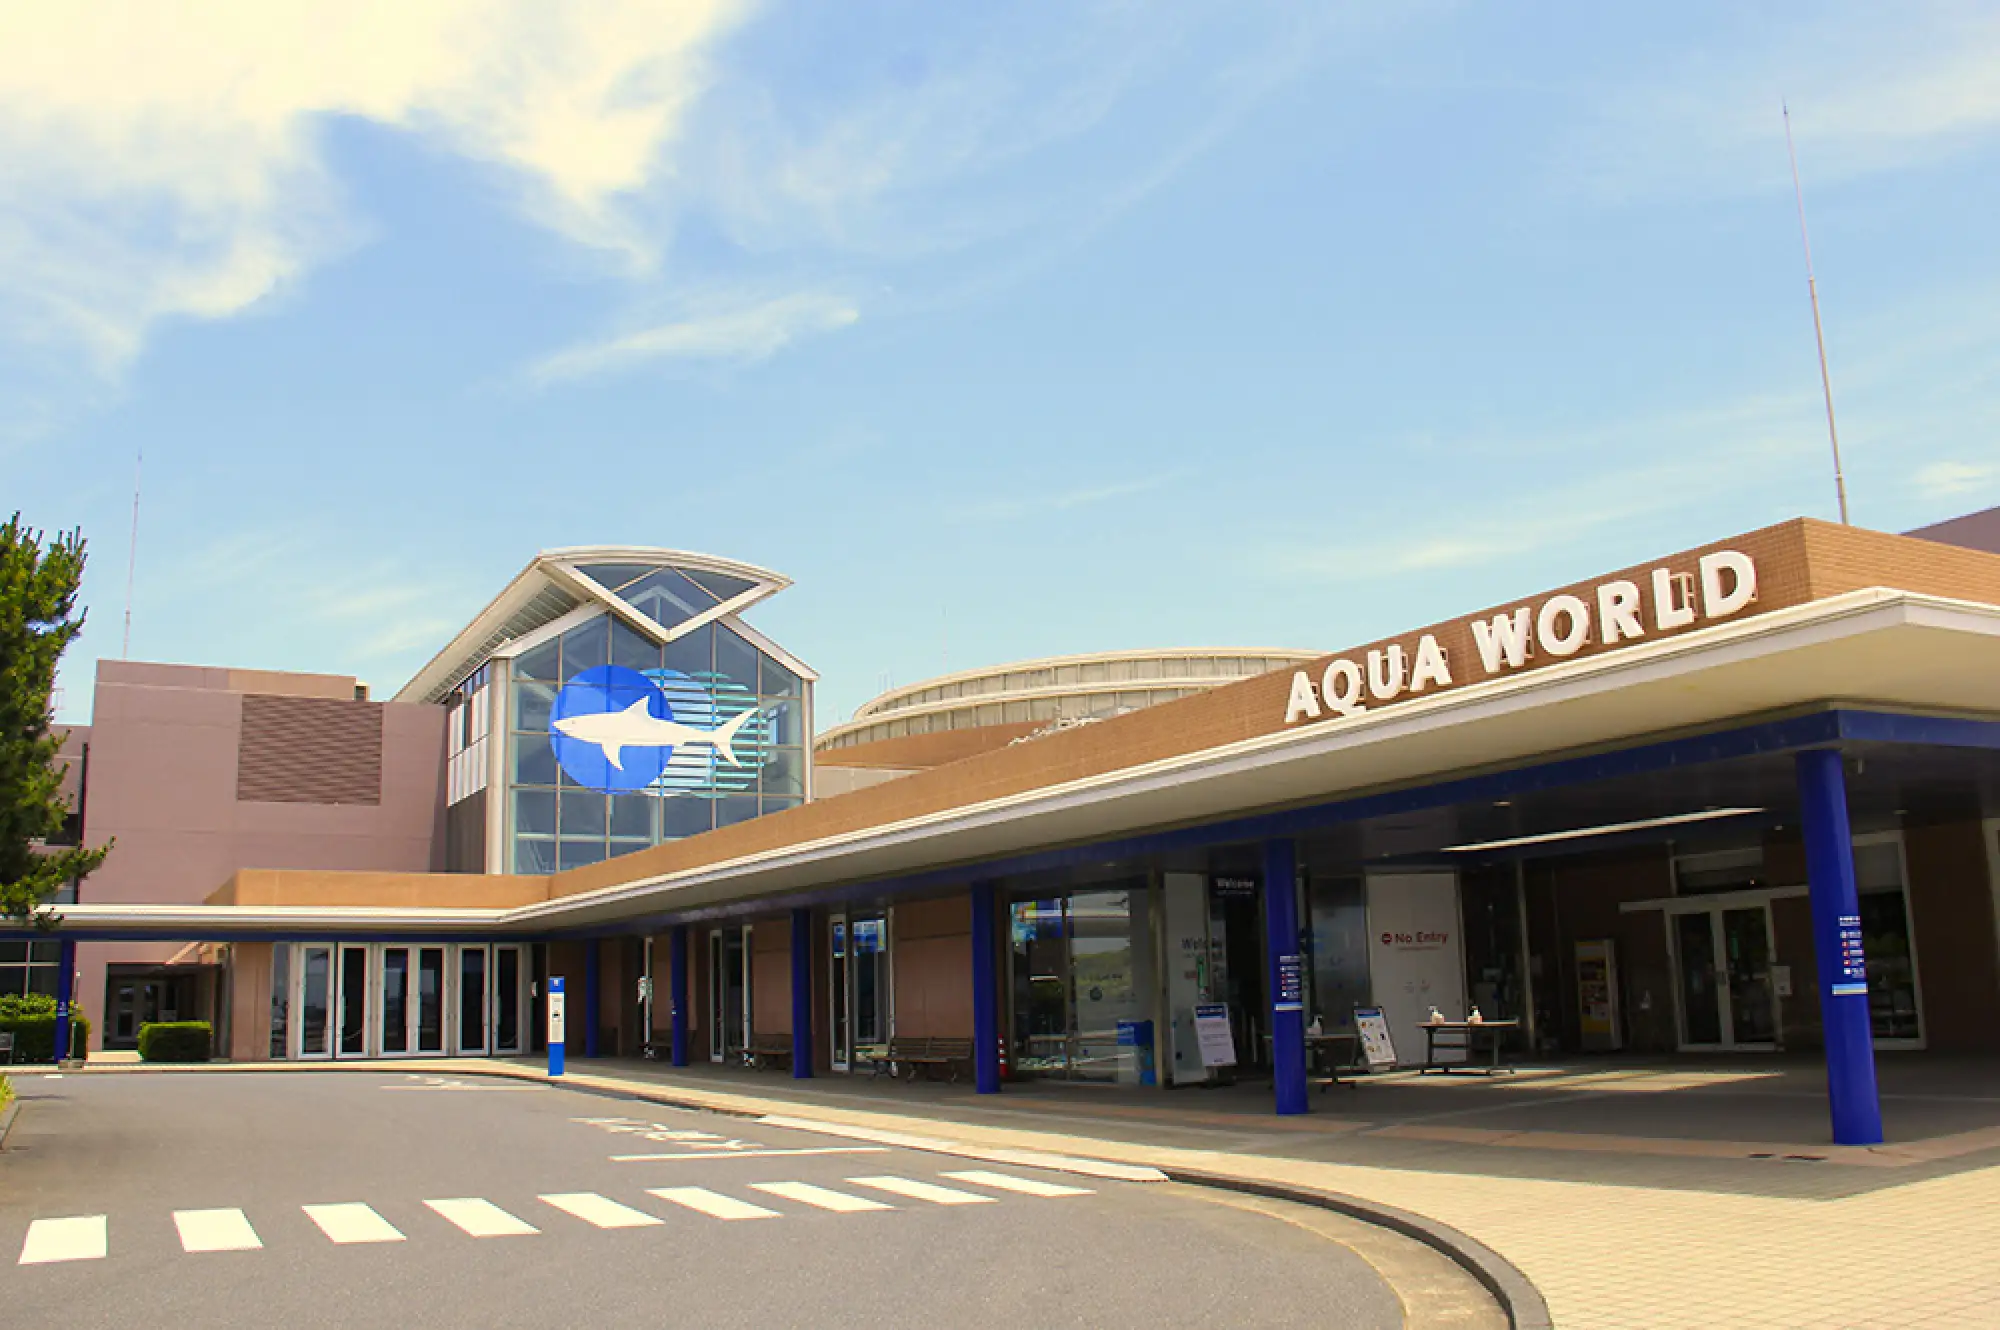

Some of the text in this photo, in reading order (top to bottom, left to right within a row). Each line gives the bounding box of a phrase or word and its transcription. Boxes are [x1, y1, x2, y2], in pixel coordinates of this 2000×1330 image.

[1284, 550, 1757, 722] AQUA WORLD
[1395, 931, 1448, 944] No Entry
